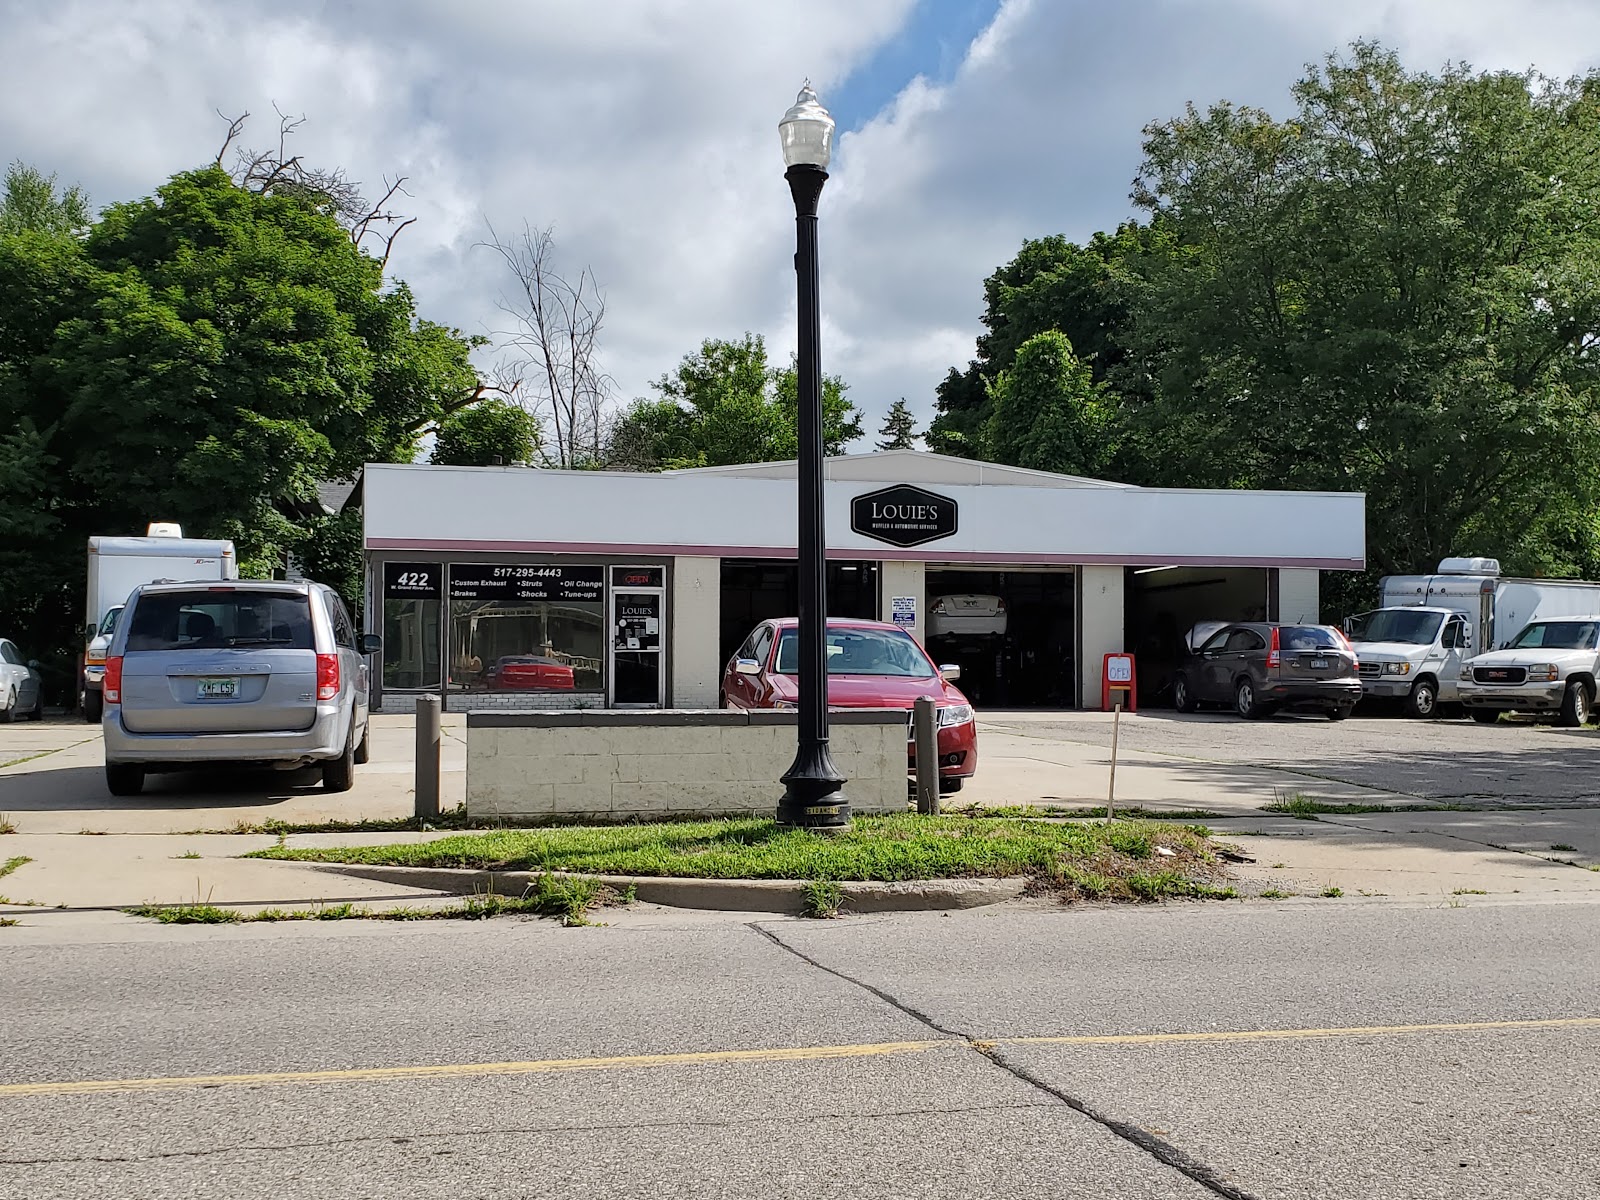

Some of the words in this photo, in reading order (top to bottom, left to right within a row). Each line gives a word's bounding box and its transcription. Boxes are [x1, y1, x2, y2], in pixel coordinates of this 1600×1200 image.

[872, 502, 938, 520] LOUIE'S
[493, 568, 562, 577] 517-295-4443
[397, 572, 429, 586] 422
[625, 575, 649, 583] OPEN
[564, 591, 597, 599] Tune-ups
